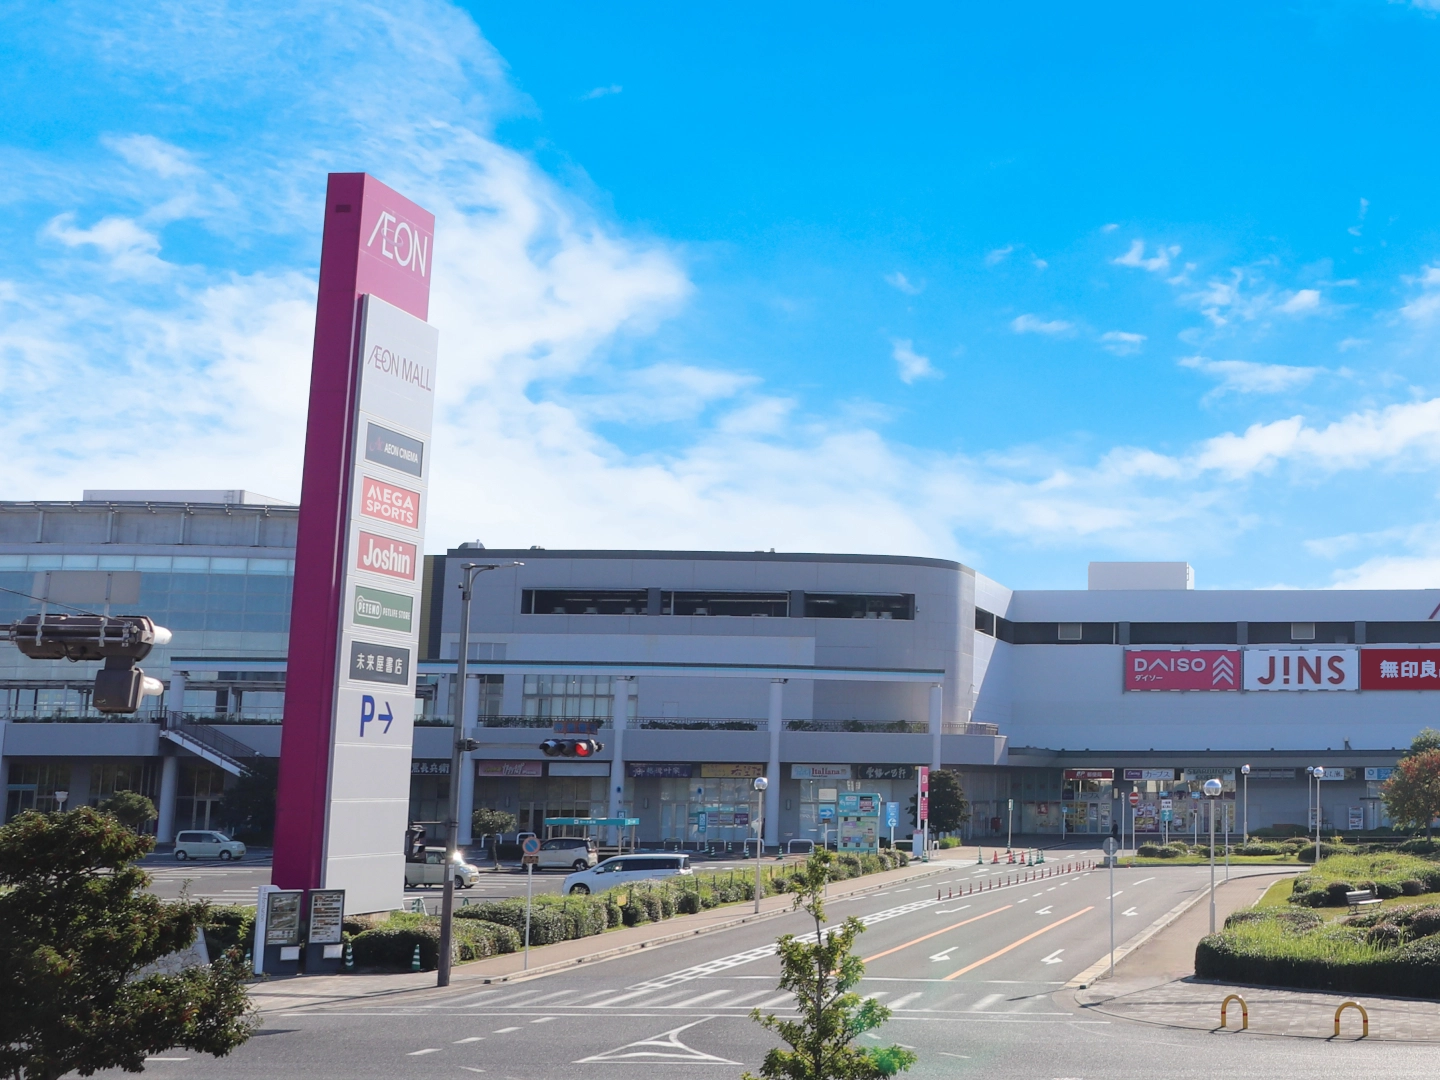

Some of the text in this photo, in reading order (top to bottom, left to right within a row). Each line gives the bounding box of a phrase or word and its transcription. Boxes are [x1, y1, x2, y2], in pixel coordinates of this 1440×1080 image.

[401, 359, 431, 392] MALL
[384, 443, 399, 457] AEON
[399, 448, 418, 463] CINEMA
[368, 484, 414, 511] MEGA
[366, 499, 414, 524] SPORTS
[363, 539, 411, 575] Joshin
[398, 610, 411, 621] STORE
[356, 653, 403, 676] 未来屋書店
[1134, 658, 1206, 672] DAISO
[1134, 674, 1163, 682] ダイソー
[360, 695, 375, 737] P
